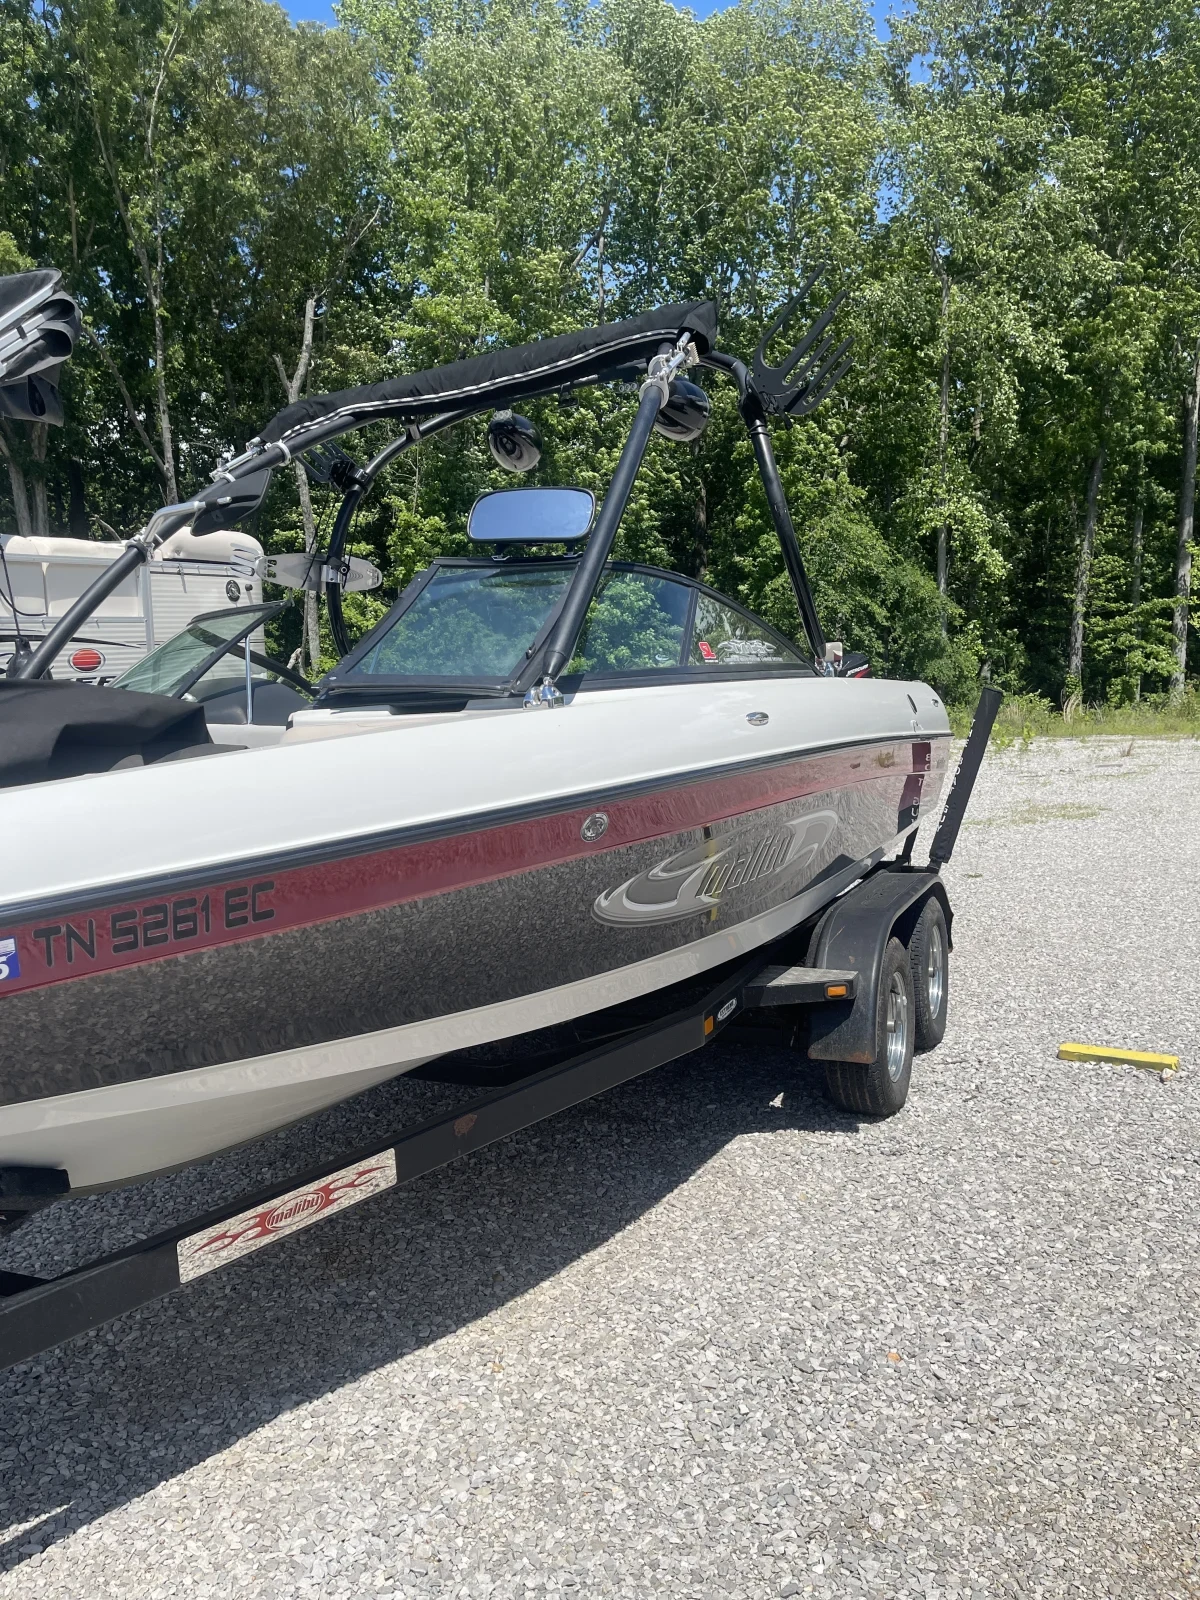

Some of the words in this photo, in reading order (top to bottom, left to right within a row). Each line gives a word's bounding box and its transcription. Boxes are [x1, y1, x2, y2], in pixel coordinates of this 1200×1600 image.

[694, 831, 796, 899] malibu
[32, 918, 95, 968] TN
[110, 893, 211, 955] 5261
[224, 880, 275, 929] EC
[269, 1195, 320, 1227] malibu
